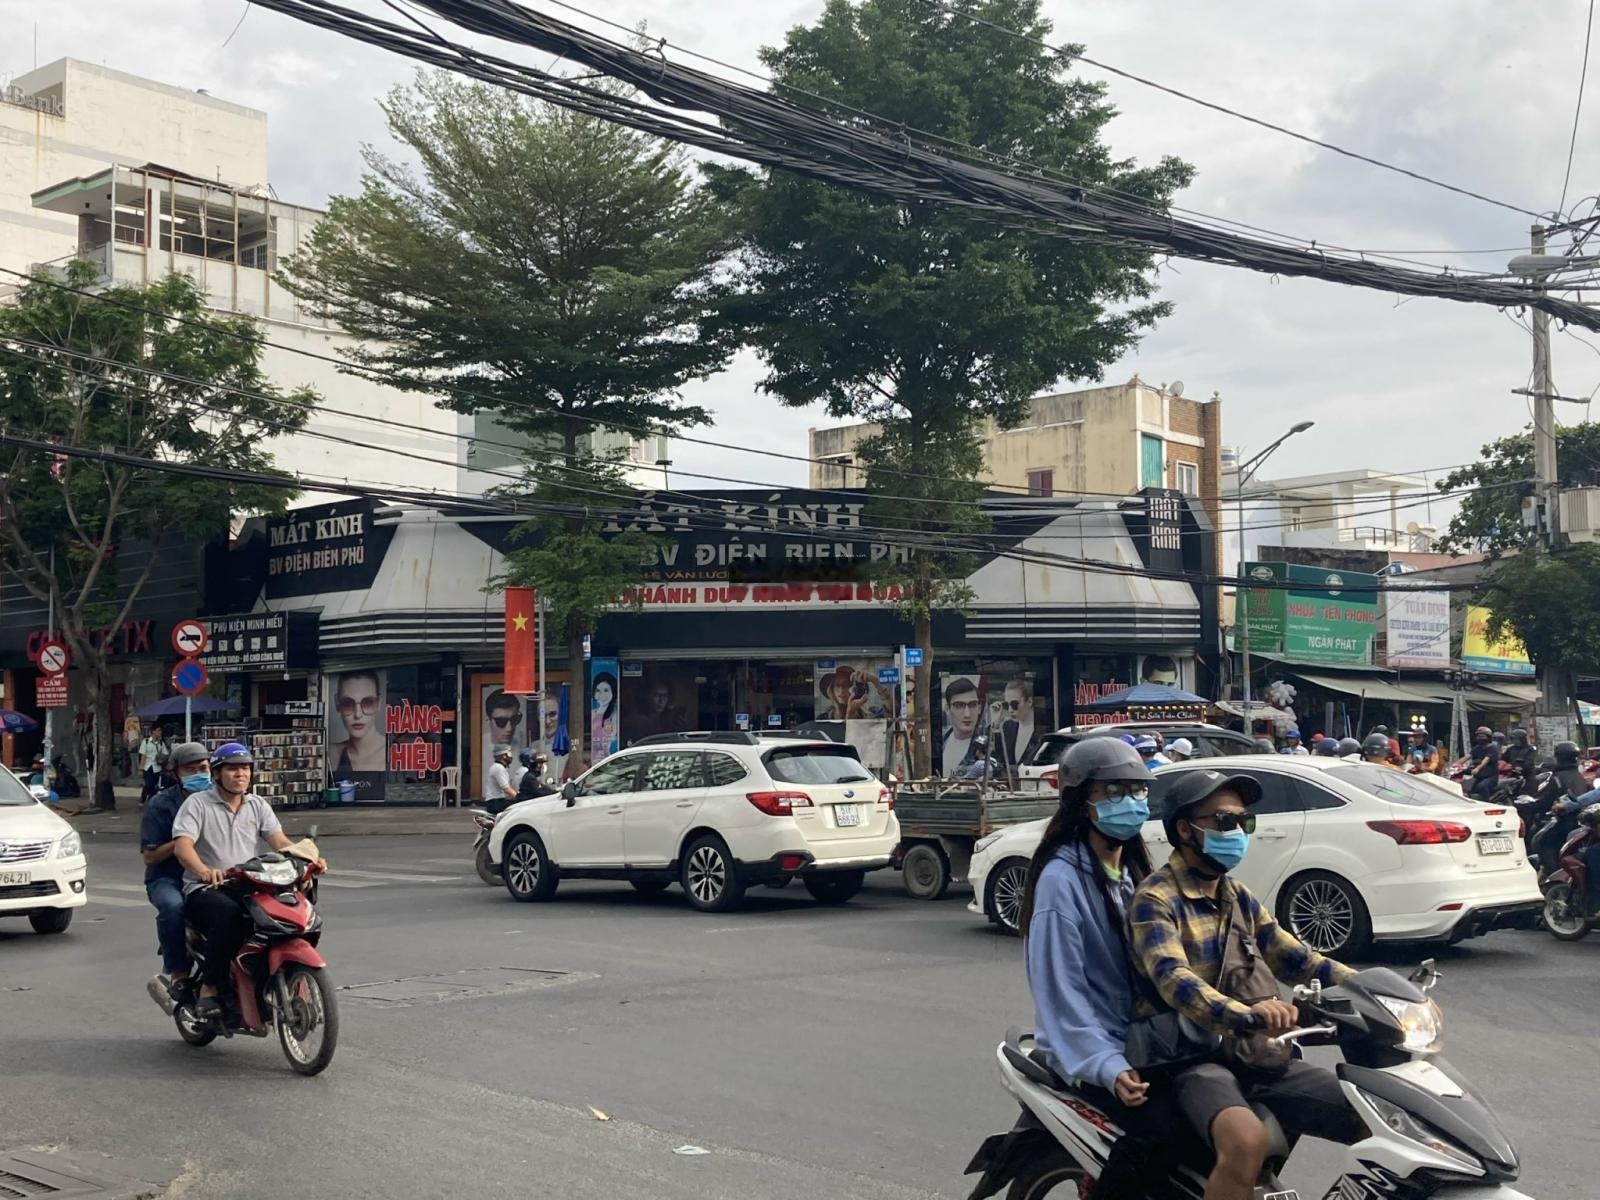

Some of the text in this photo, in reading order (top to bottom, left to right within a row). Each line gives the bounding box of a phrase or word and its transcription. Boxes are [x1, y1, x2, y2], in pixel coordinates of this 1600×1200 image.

[270, 508, 364, 547] MẮT KÍNH
[720, 492, 865, 532] KÍNH
[1151, 521, 1181, 550] KÍNH
[269, 538, 365, 576] BV ĐIỆN BIÊN PHỦ
[640, 543, 680, 567] BV
[869, 542, 916, 566] PH
[664, 570, 696, 579] VĂN
[385, 698, 443, 734] HÀNG
[389, 736, 443, 779] HIỆU
[0, 872, 28, 884] 64.21
